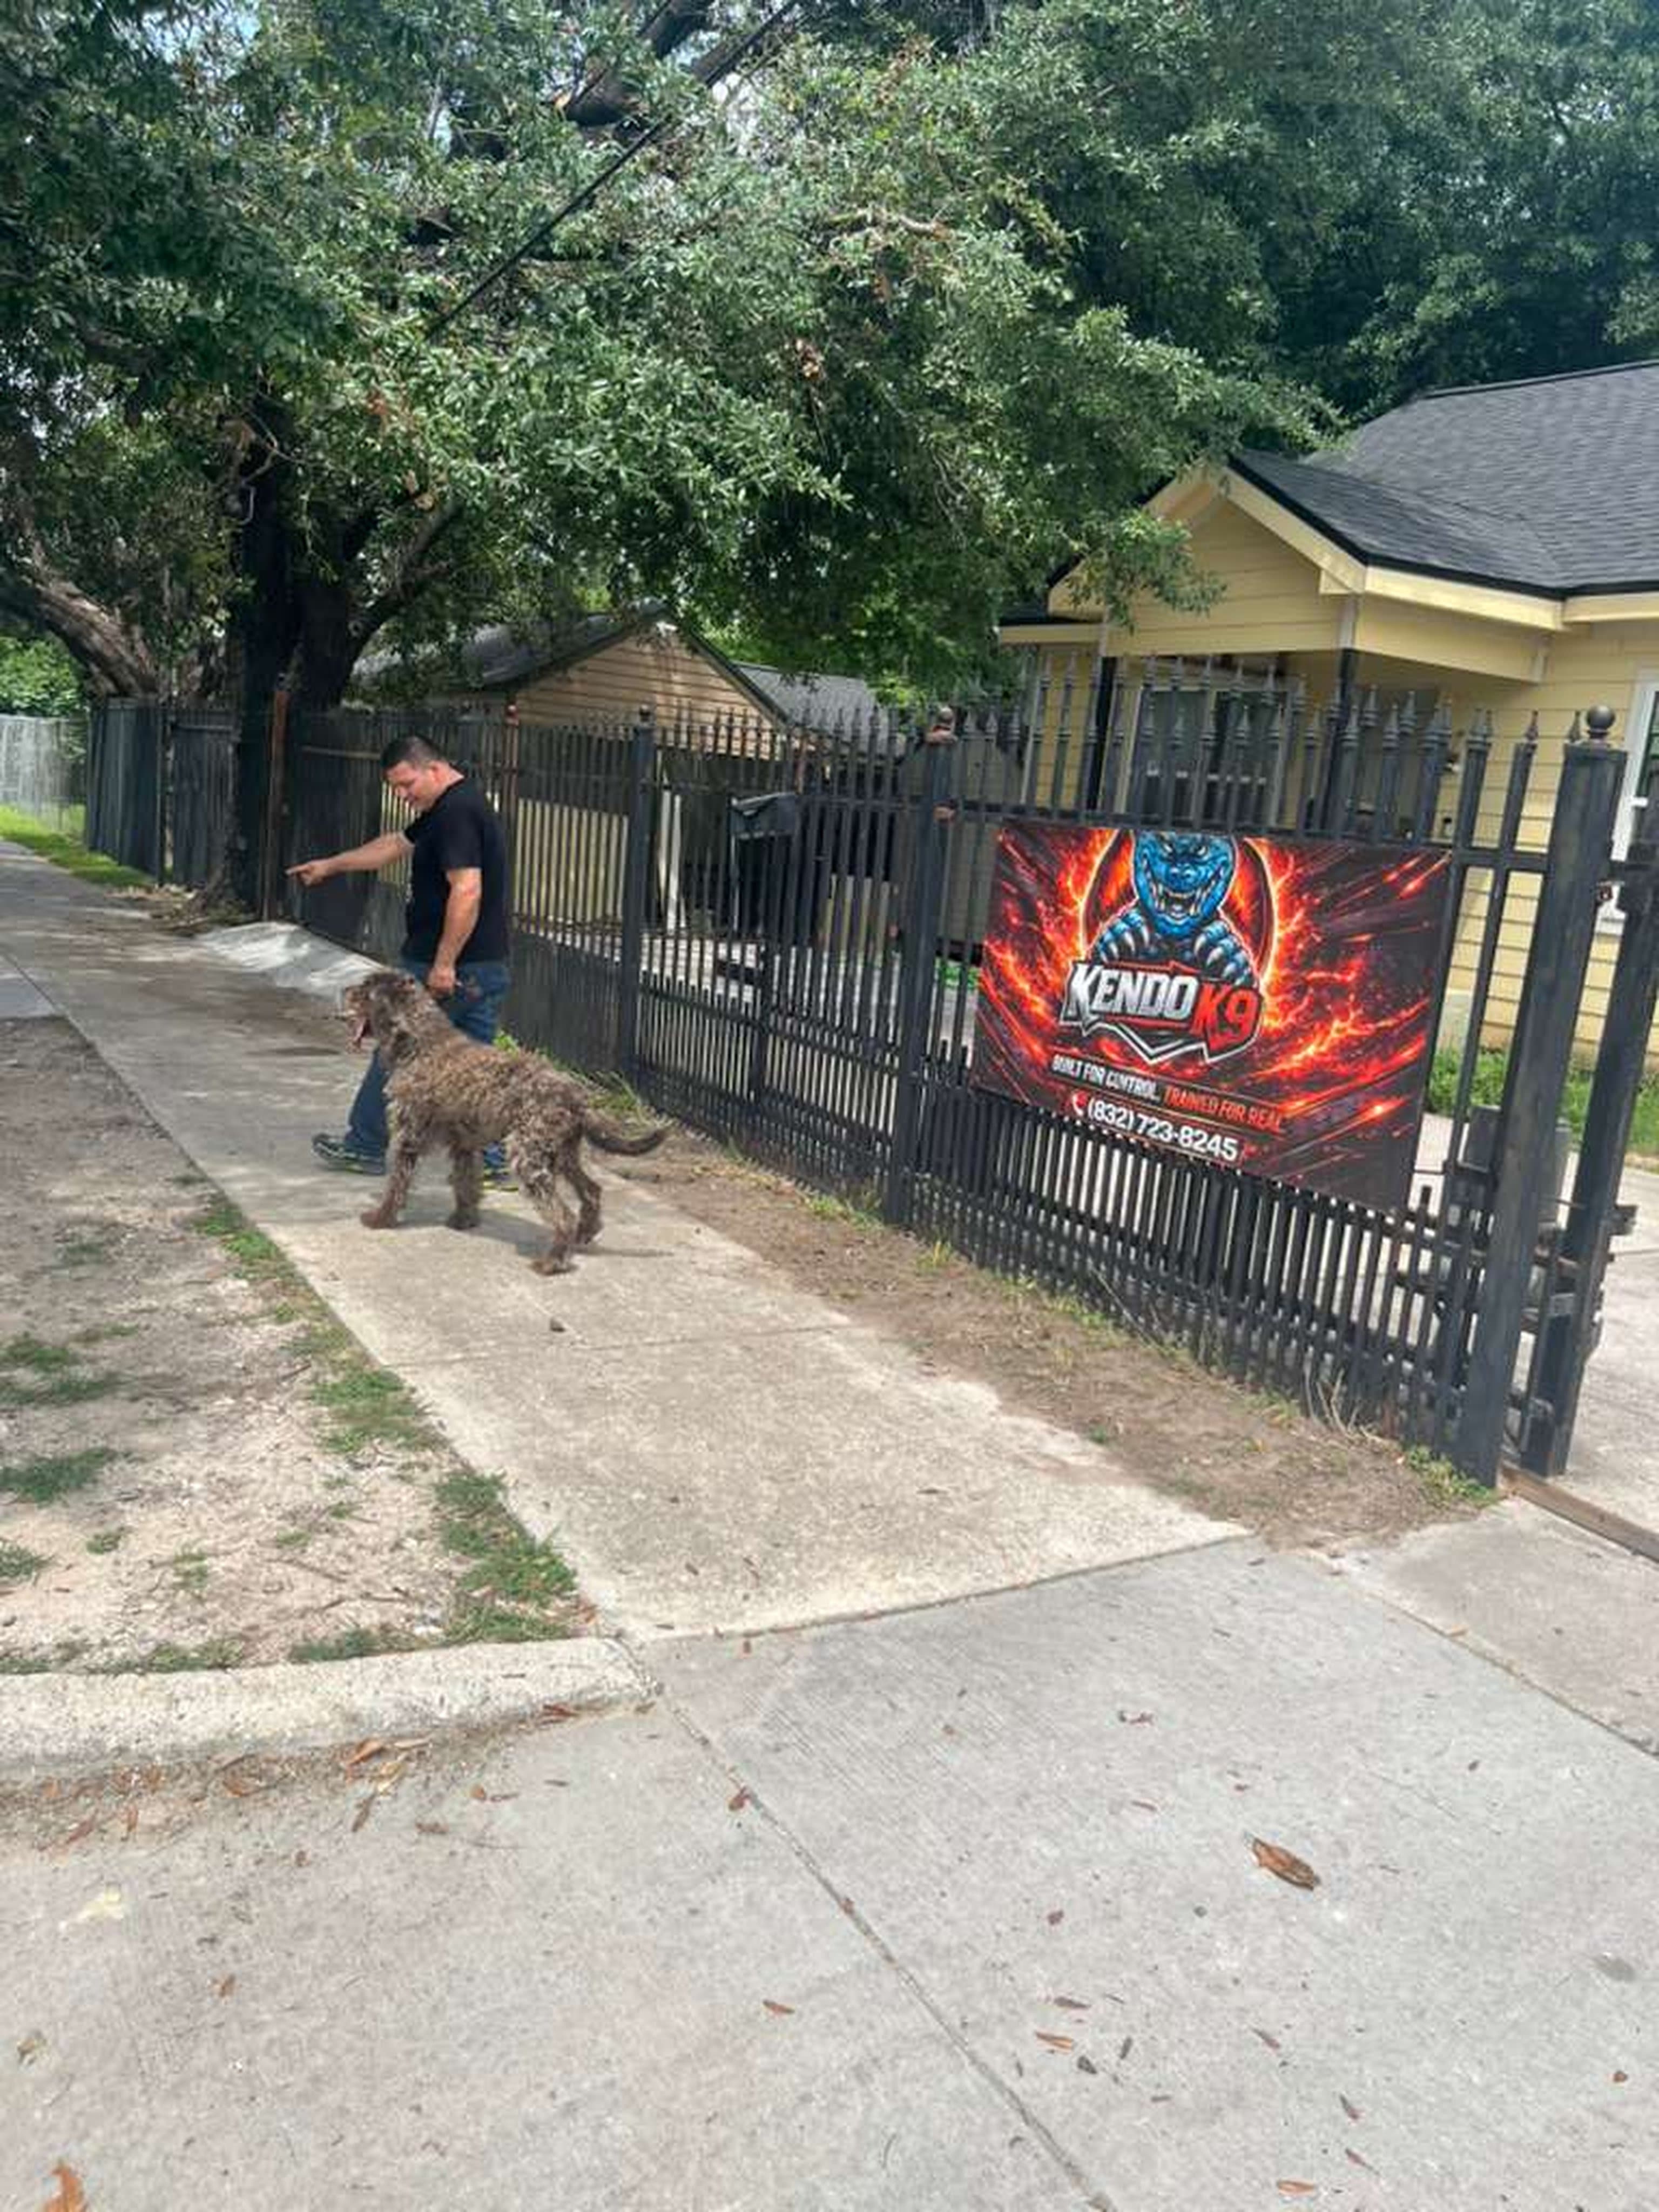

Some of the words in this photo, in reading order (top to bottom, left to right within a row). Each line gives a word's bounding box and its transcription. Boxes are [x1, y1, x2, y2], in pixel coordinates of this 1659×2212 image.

[1068, 963, 1199, 1025] KENDO
[1190, 982, 1258, 1050] K9
[1052, 1054, 1082, 1077] BUILT
[1082, 1062, 1105, 1085] FOR
[1164, 1085, 1218, 1114] TRAINED
[1218, 1100, 1246, 1122] FOR
[1088, 1097, 1135, 1130] (832)
[1136, 1113, 1238, 1161] 723-8245
